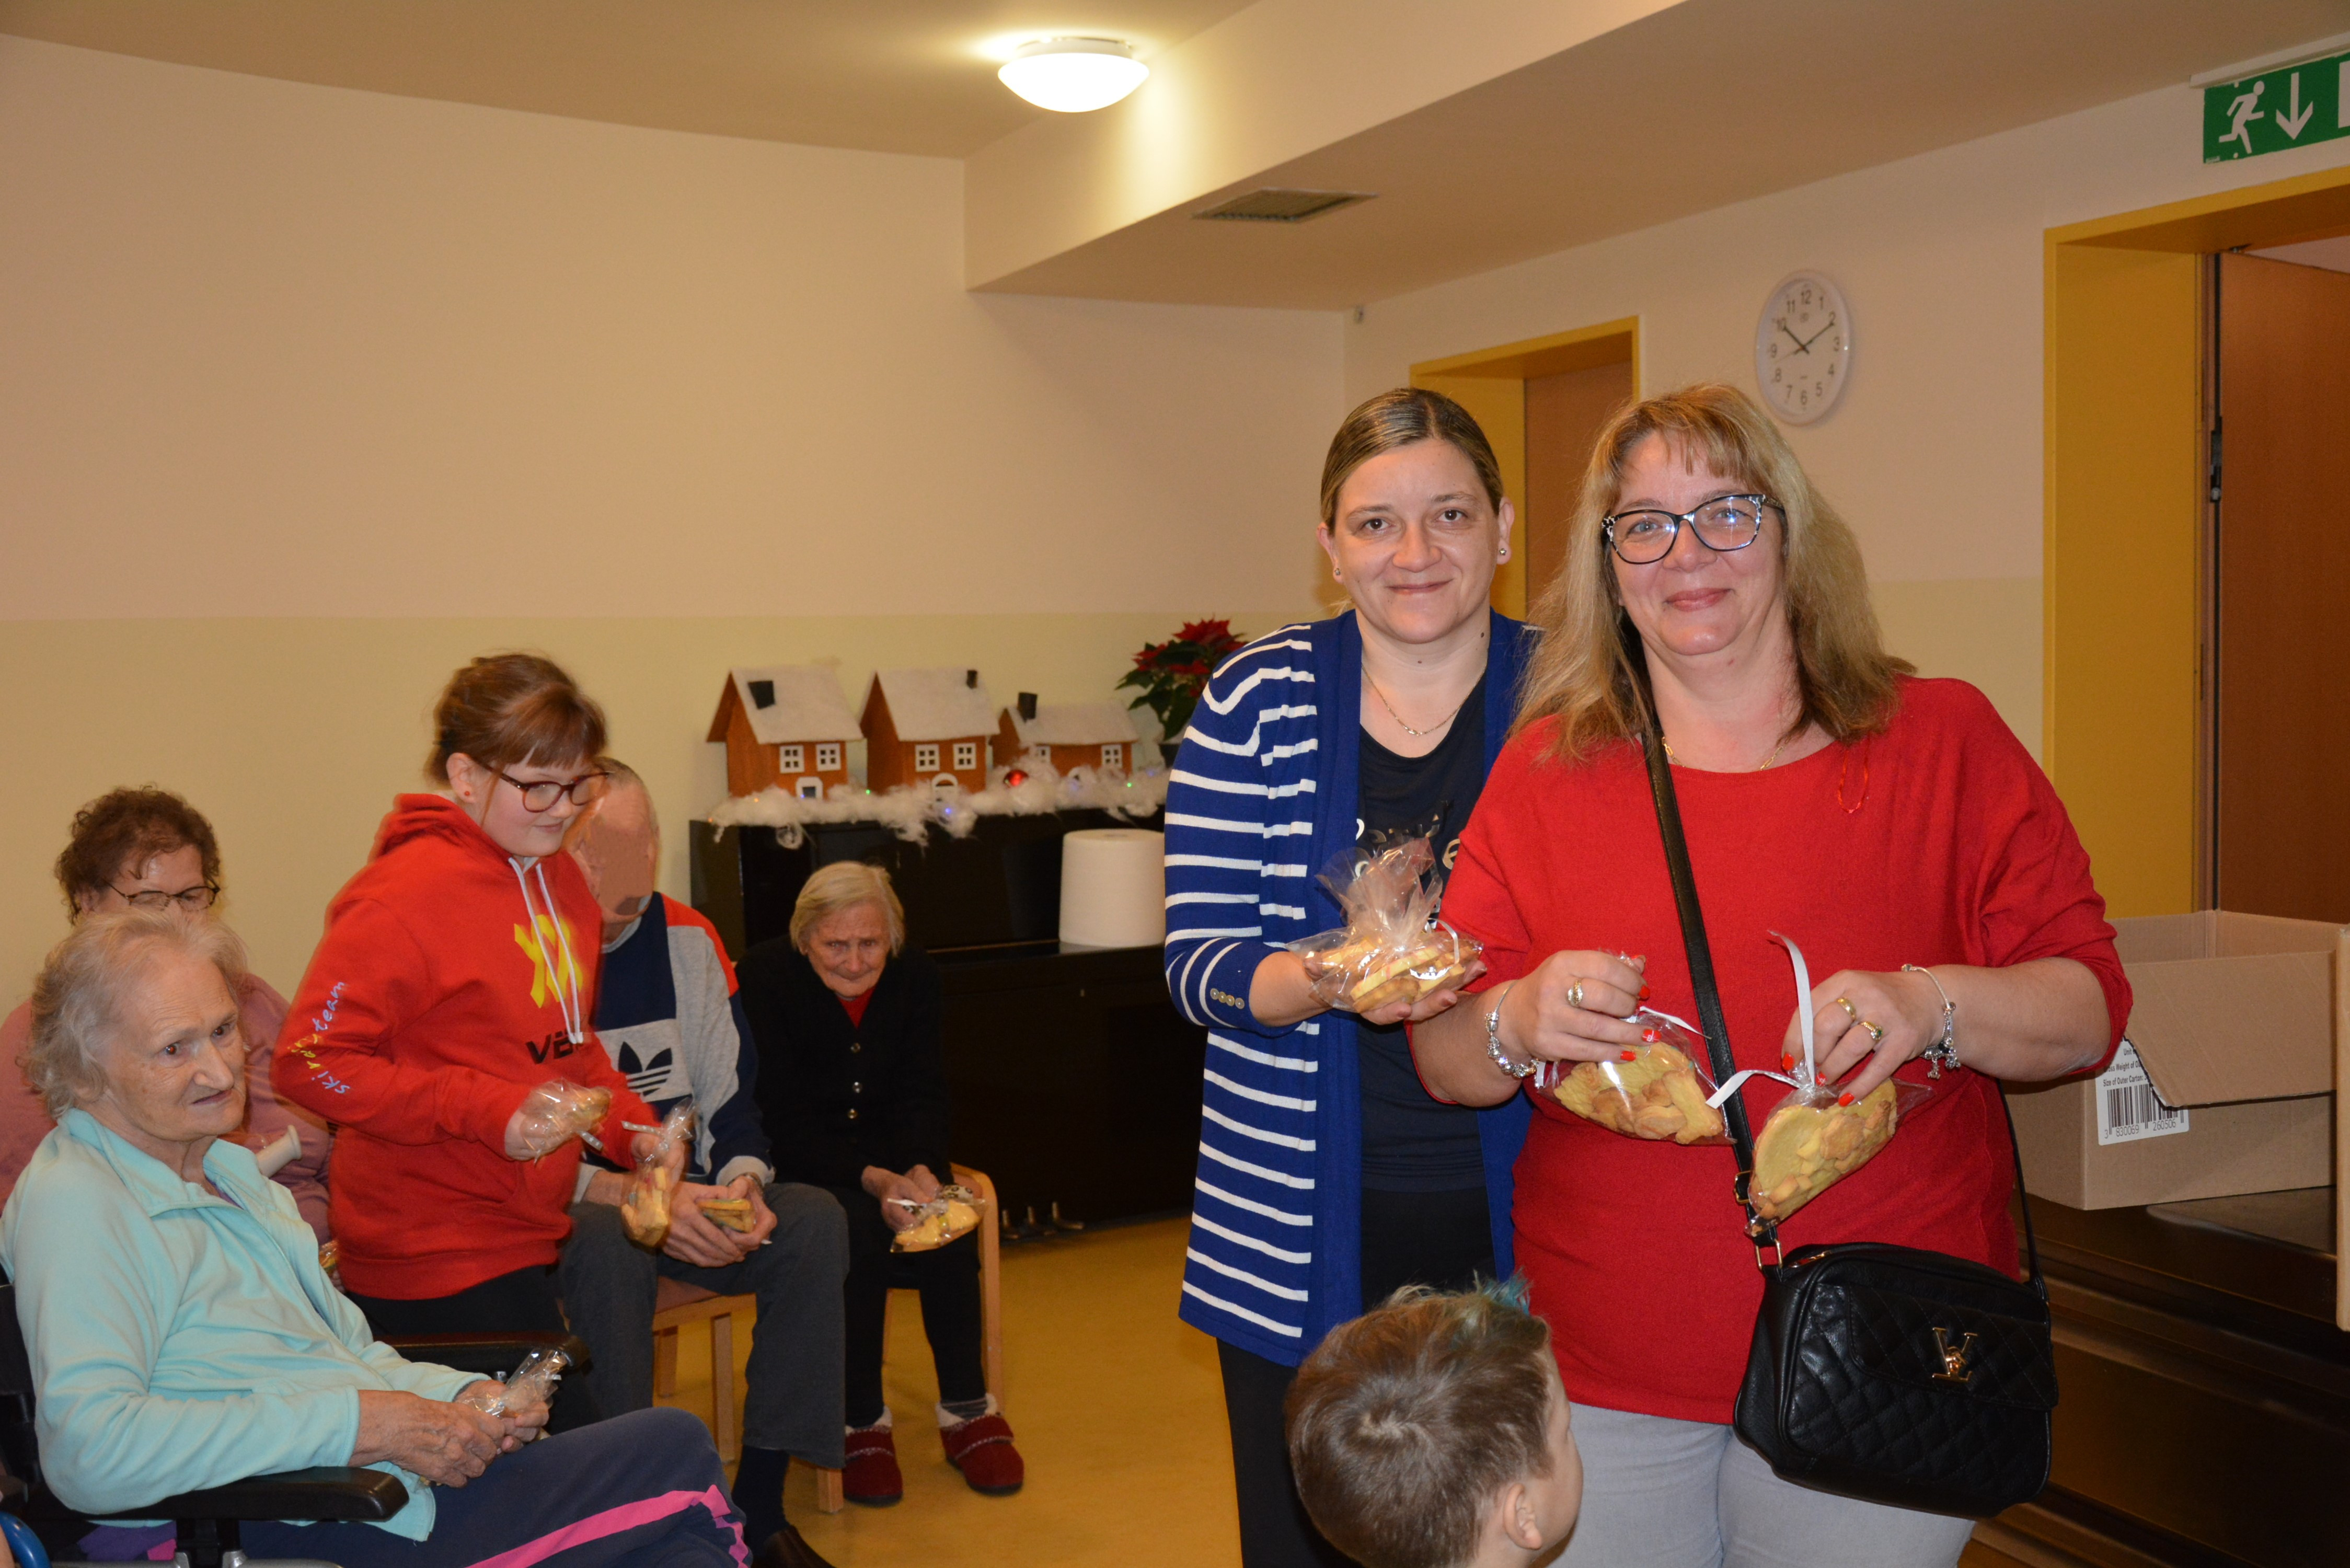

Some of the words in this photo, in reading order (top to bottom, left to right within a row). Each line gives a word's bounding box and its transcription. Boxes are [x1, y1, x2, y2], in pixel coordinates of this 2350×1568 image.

[1800, 289, 1812, 305] 12
[1819, 296, 1824, 310] 1
[1786, 299, 1795, 313] 11
[1770, 343, 1777, 358] 9
[1834, 336, 1840, 352] 3
[1775, 367, 1782, 383] 8
[1828, 364, 1835, 378] 4
[1787, 384, 1793, 399] 7
[1816, 381, 1823, 397] 5
[1800, 389, 1807, 406] 6
[312, 982, 345, 1032] team
[2123, 1047, 2132, 1056] Unit
[2116, 1063, 2130, 1071] Weight
[2104, 1129, 2109, 1139] 3
[2116, 1124, 2139, 1137] 830069
[2153, 1119, 2176, 1131] 260506
